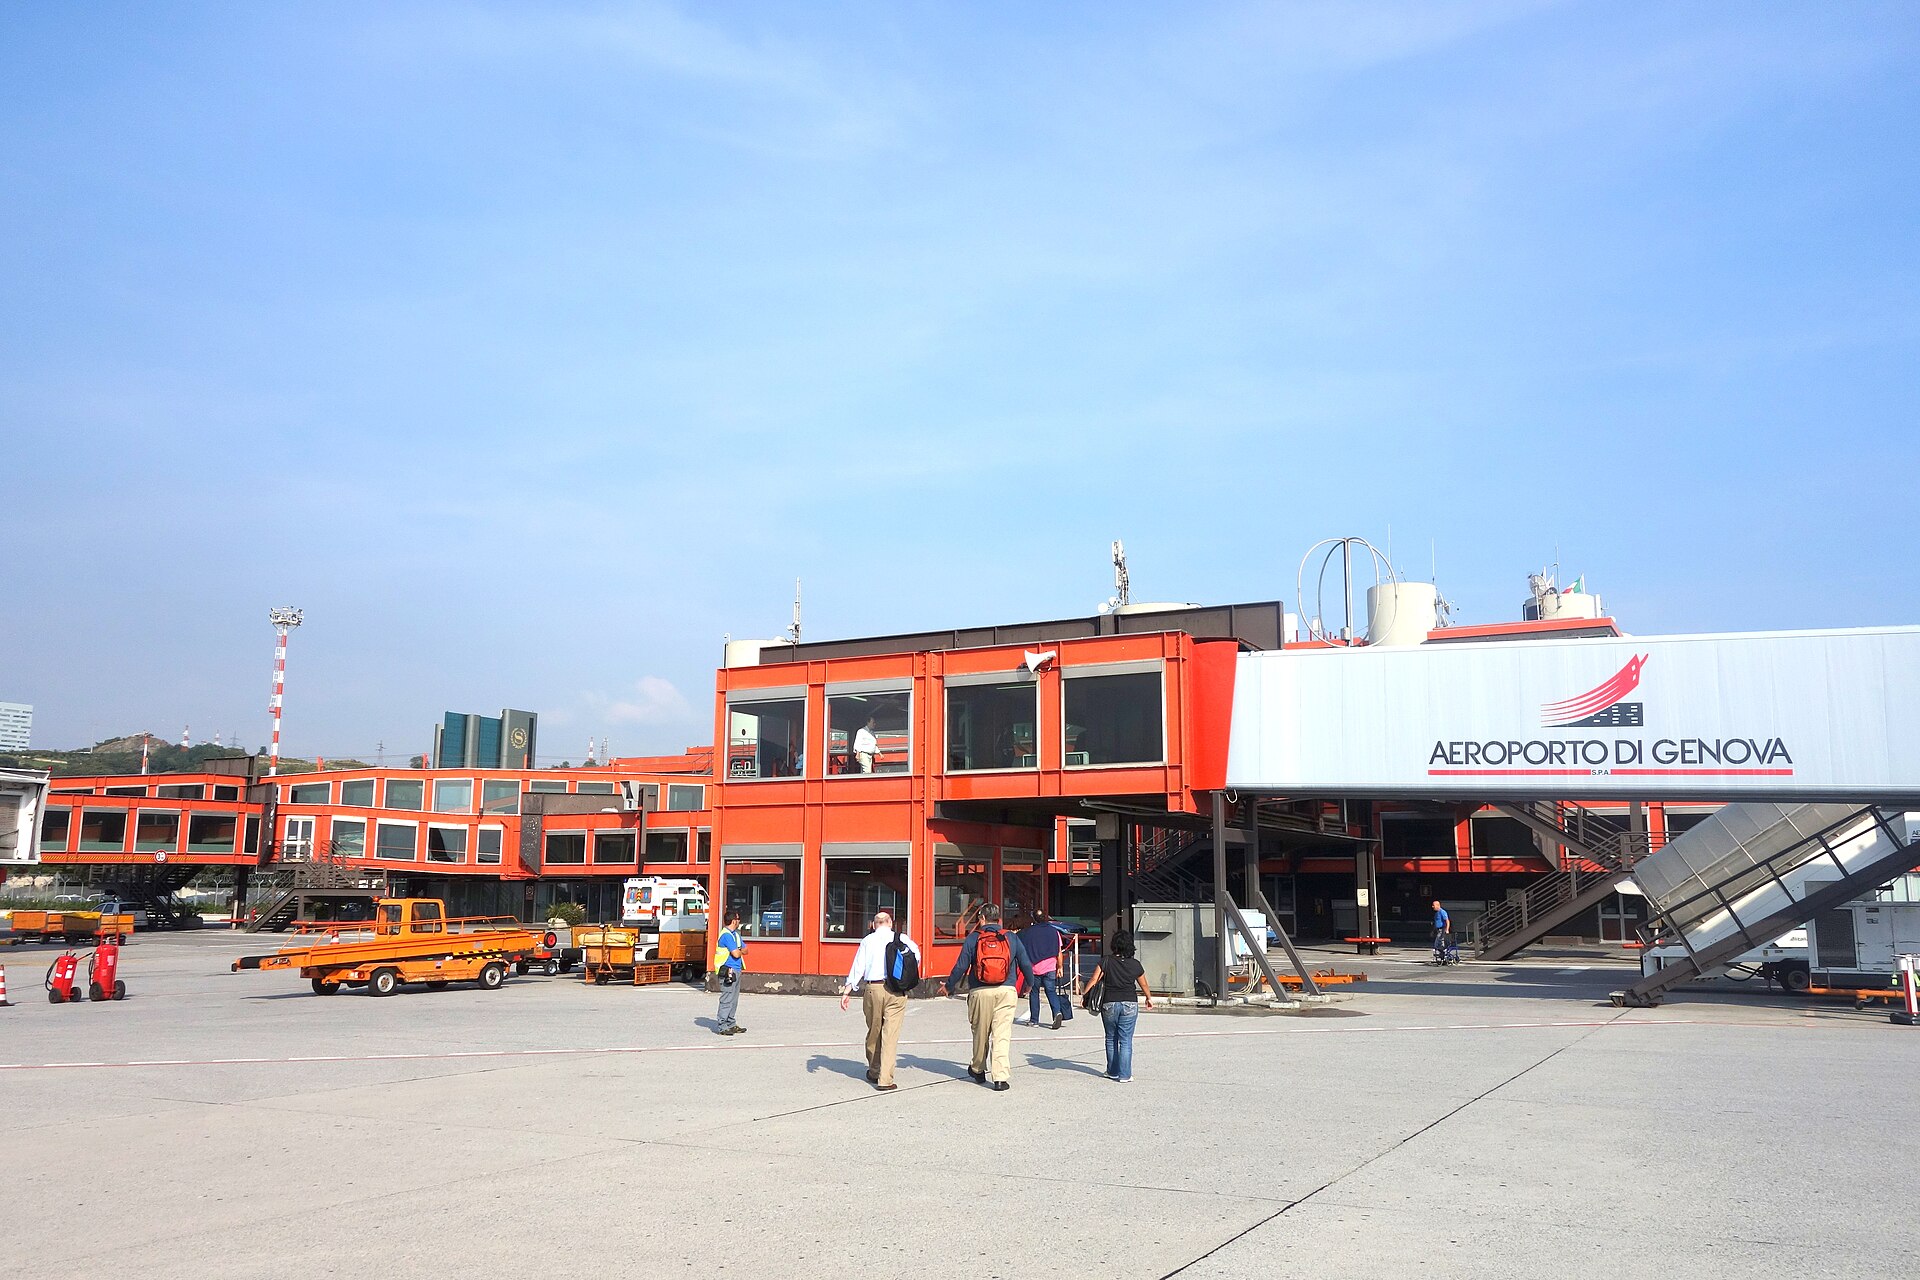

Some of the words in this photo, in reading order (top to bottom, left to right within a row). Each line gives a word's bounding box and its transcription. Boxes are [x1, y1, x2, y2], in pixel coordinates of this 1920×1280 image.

[1429, 740, 1608, 765] AEROPORTO
[1615, 739, 1643, 764] DI
[1652, 737, 1793, 765] GENOVA
